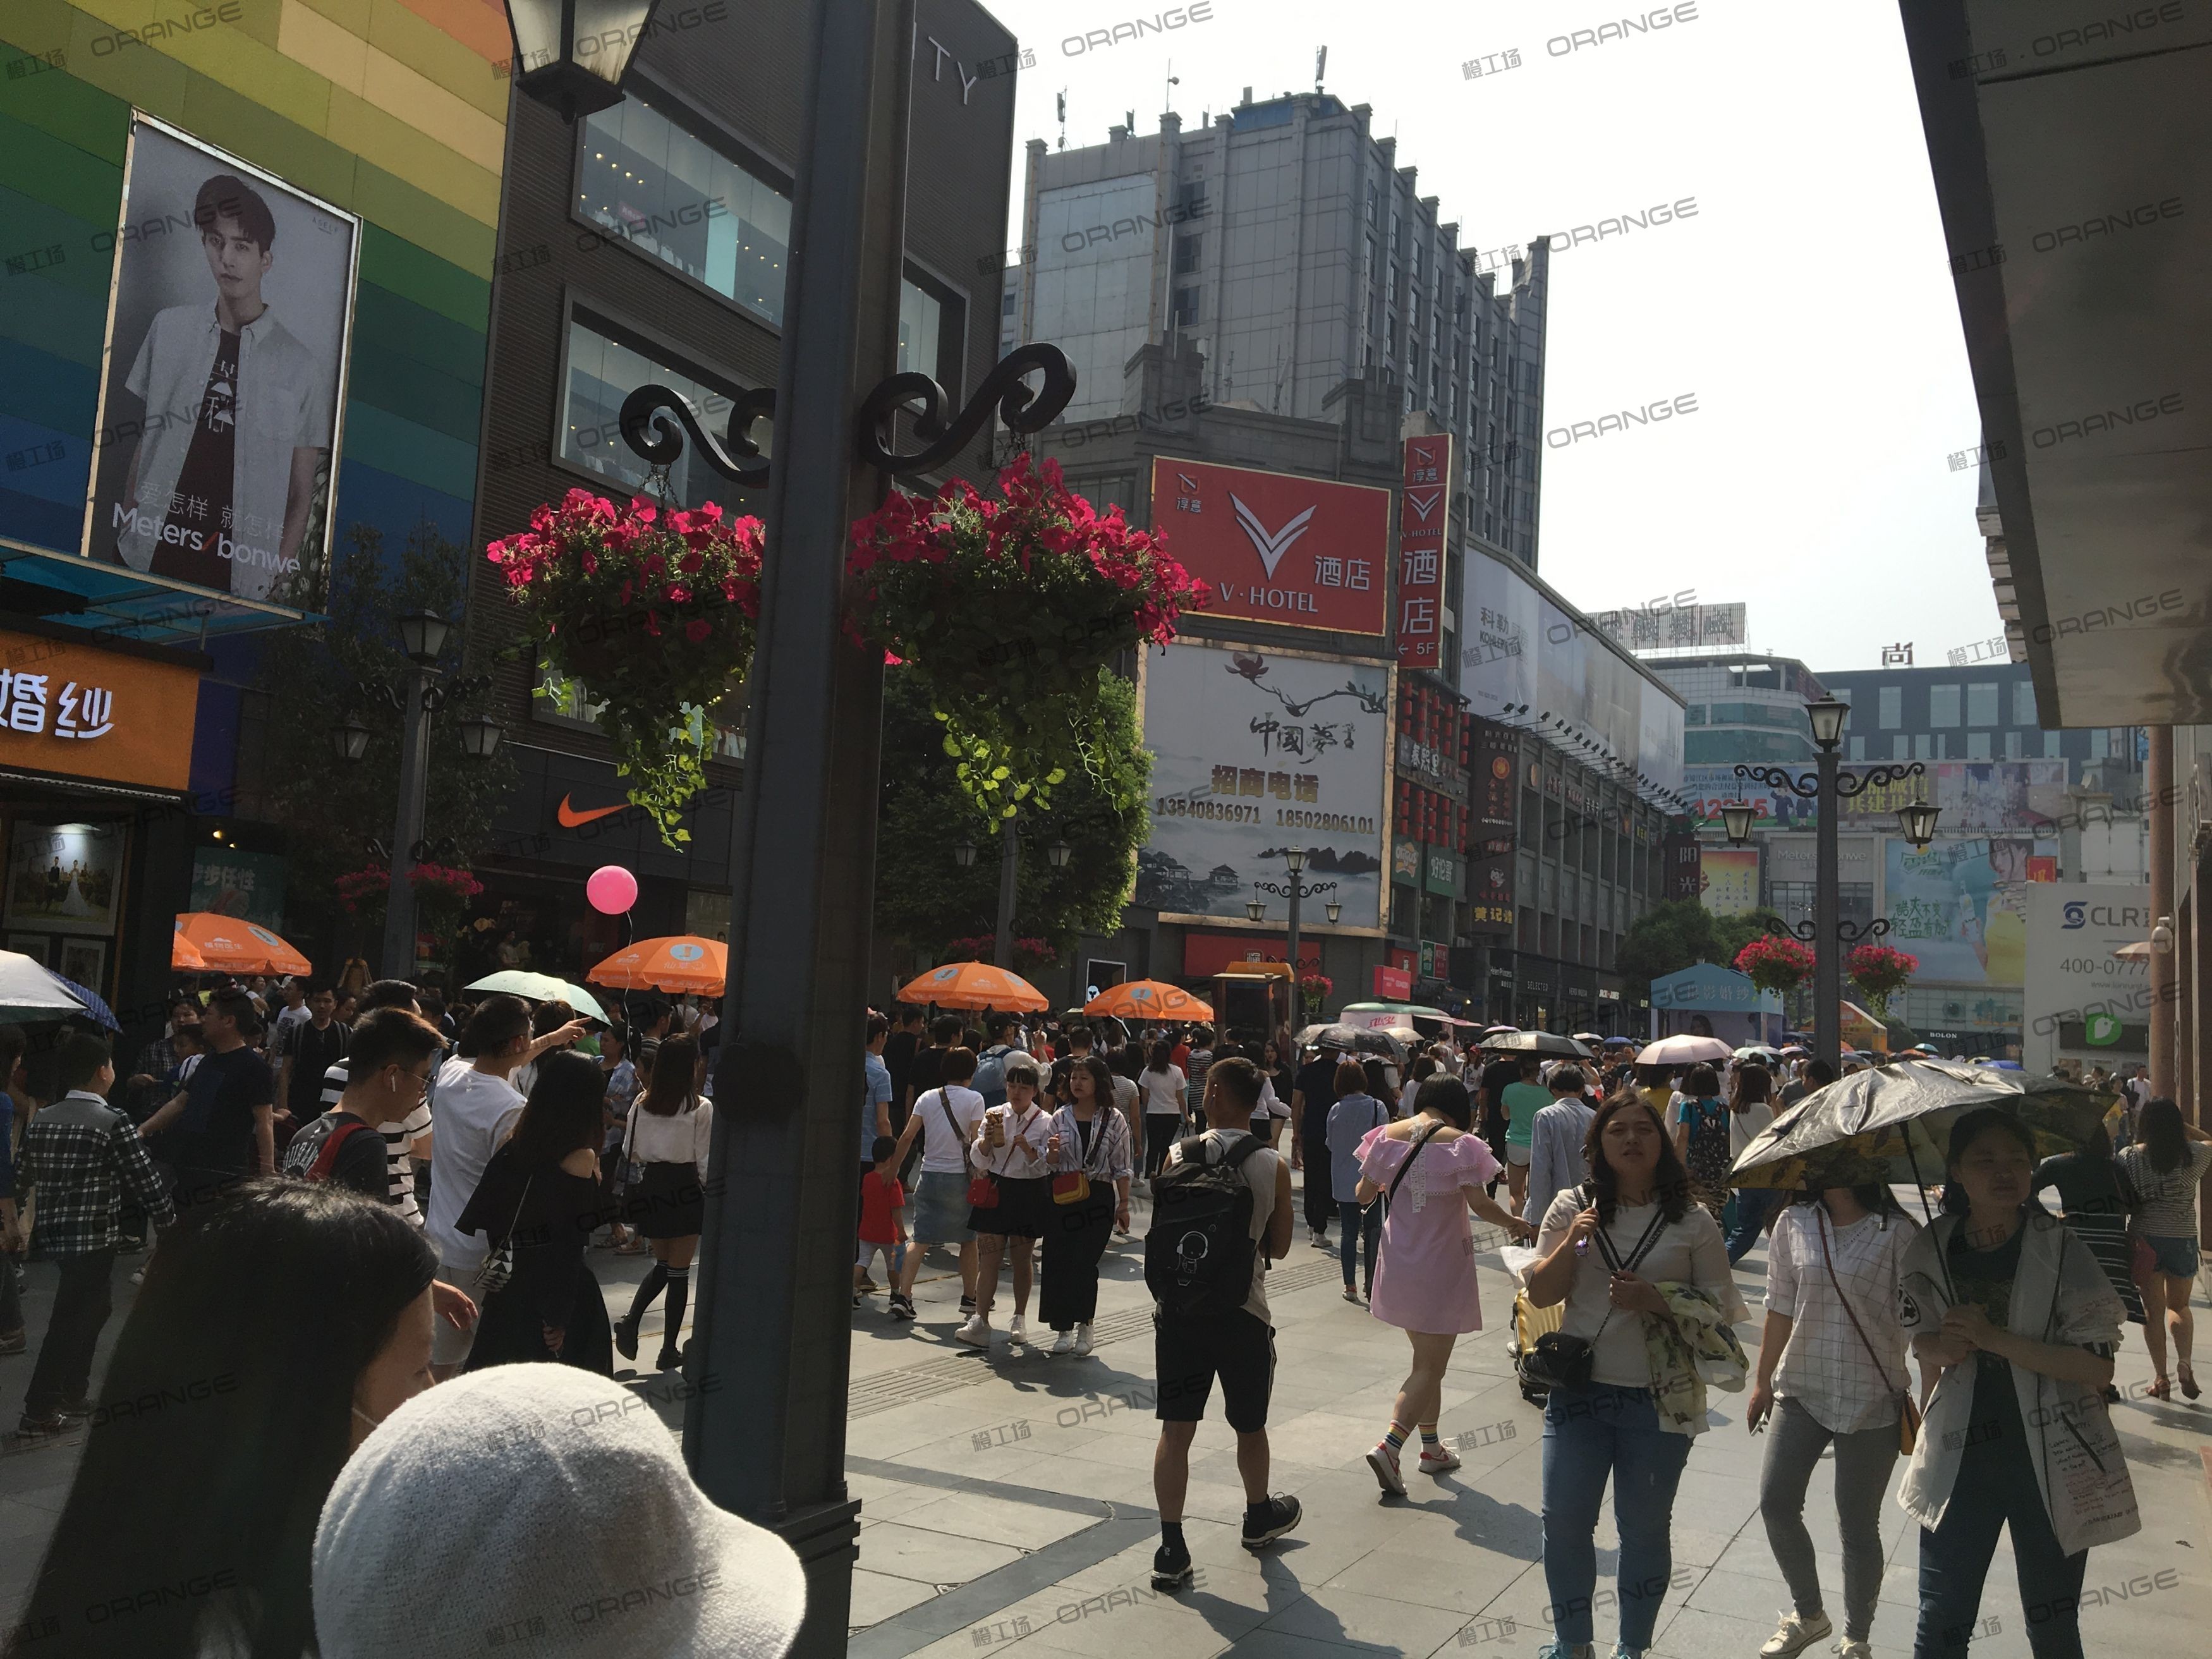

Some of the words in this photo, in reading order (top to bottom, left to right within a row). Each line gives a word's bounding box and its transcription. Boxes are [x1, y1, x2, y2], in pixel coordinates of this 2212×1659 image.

[140, 480, 209, 521] 爱怎样
[221, 502, 285, 540] 就怎样
[1315, 554, 1371, 591] 酒店
[1401, 549, 1438, 635] 酒店
[1416, 642, 1435, 655] 5F
[1881, 643, 1914, 665] 尚
[1211, 765, 1320, 803] 招商电话
[1157, 797, 1261, 824] 13540836971
[1276, 808, 1375, 835] 18502806101
[1679, 846, 1697, 892] 阳光
[1527, 980, 1548, 992] SELECTED
